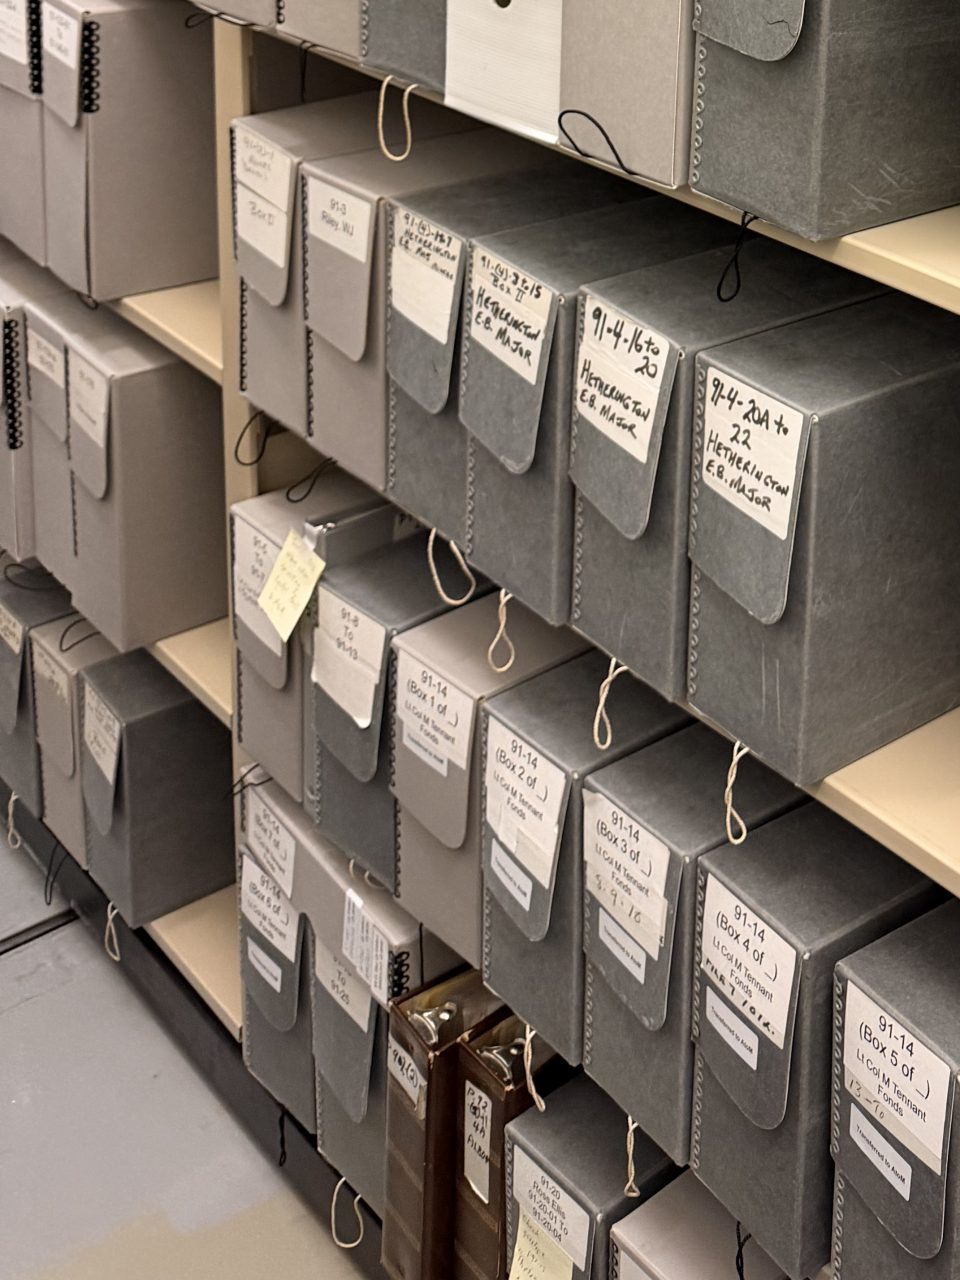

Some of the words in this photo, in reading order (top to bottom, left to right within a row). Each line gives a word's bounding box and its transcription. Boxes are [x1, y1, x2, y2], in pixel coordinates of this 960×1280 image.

[476, 285, 541, 341] HETHERINGTON
[635, 356, 658, 378] 20
[581, 358, 651, 422] HETHERINGTON
[600, 405, 637, 439] MAJOR
[730, 423, 751, 450] 22
[774, 414, 788, 436] to
[706, 429, 789, 497] HETHERINGTON
[729, 477, 771, 512] MAJOR
[421, 670, 447, 698] 91-14
[419, 725, 439, 745] Fonds
[511, 739, 538, 769] 91-14
[494, 771, 500, 784] Lt
[500, 779, 511, 793] Col
[510, 786, 518, 799] M
[518, 793, 544, 822] Tennant
[507, 797, 526, 820] Fonds
[611, 811, 640, 843] 91-14
[595, 844, 602, 856] Lt
[603, 851, 614, 867] Col
[614, 860, 621, 873] M
[622, 865, 650, 897] Tennant
[611, 871, 632, 896] Fonds
[734, 905, 765, 943] 91-14
[712, 936, 719, 950] Lt
[720, 943, 734, 963] Col
[735, 958, 742, 972] M
[743, 963, 774, 1003] Tennant
[730, 970, 753, 998] Fonds
[878, 1015, 914, 1057] 91-14
[856, 1048, 865, 1062] Lt
[865, 1058, 880, 1079] Col
[882, 1072, 891, 1089] M
[892, 1082, 927, 1123] Tennant
[878, 1084, 904, 1117] Fonds
[856, 1125, 884, 1163] Transferred
[884, 1158, 891, 1169] to
[891, 1166, 906, 1185] AtoM
[532, 1182, 551, 1207] Ross
[551, 1200, 566, 1221] Ellis
[540, 1175, 560, 1200] 91-20
[528, 1189, 558, 1225] 91-20-01
[560, 1221, 568, 1235] To
[533, 1207, 562, 1242] 91-20-04
